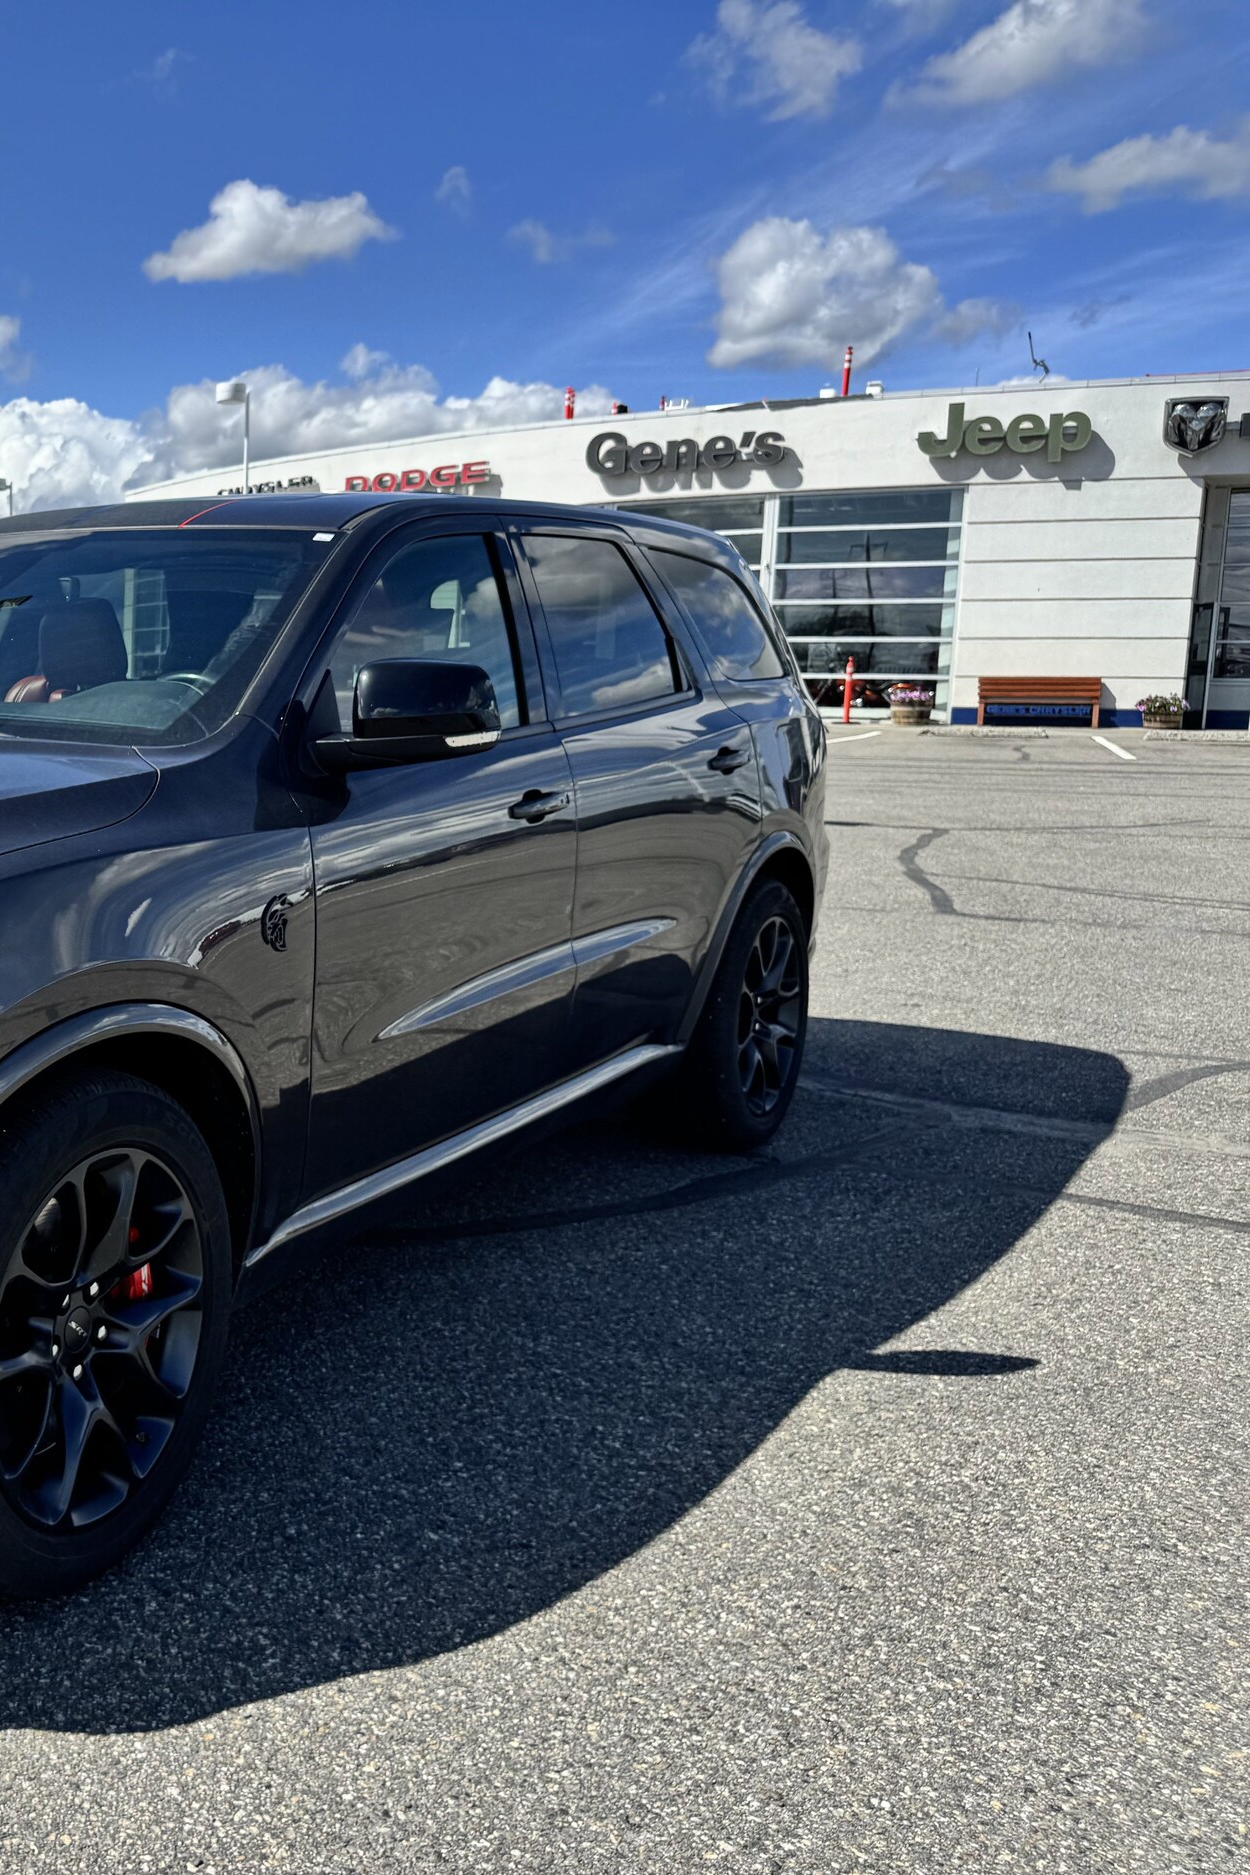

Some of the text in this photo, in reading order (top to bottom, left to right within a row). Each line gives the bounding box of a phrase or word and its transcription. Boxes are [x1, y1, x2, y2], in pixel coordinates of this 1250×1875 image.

[586, 431, 786, 475] Gene's
[916, 402, 1092, 463] Jeep
[345, 460, 491, 493] DODGE
